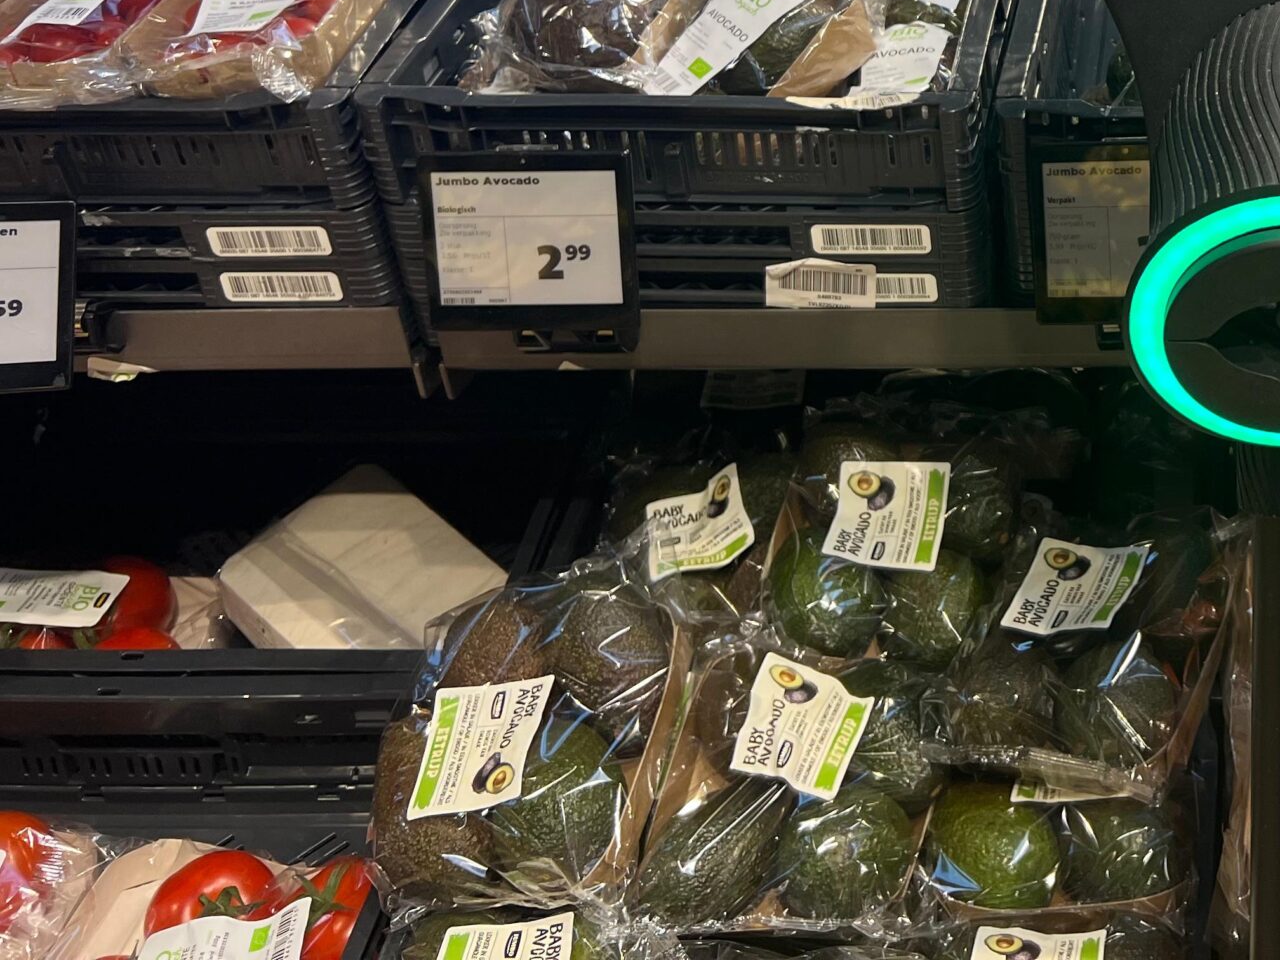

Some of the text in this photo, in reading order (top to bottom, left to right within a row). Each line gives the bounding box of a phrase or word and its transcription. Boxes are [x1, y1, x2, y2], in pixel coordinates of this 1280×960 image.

[705, 8, 749, 43] AVOCADO
[872, 46, 935, 58] AVOCADO
[435, 176, 540, 186] Jumbo Avocado
[1046, 166, 1142, 177] Jumbo Avocado
[437, 206, 476, 214] Biologisch
[653, 504, 684, 519] BABY
[833, 528, 851, 552] BABY
[849, 510, 872, 556] AVOCADO
[71, 585, 100, 611] BIO
[1013, 597, 1035, 625] BABY
[1028, 577, 1060, 627] AVOCADO
[523, 682, 543, 718] BABY
[499, 687, 529, 751] AVOCADO
[425, 725, 449, 779] EETRIJP
[739, 725, 768, 766] BABY
